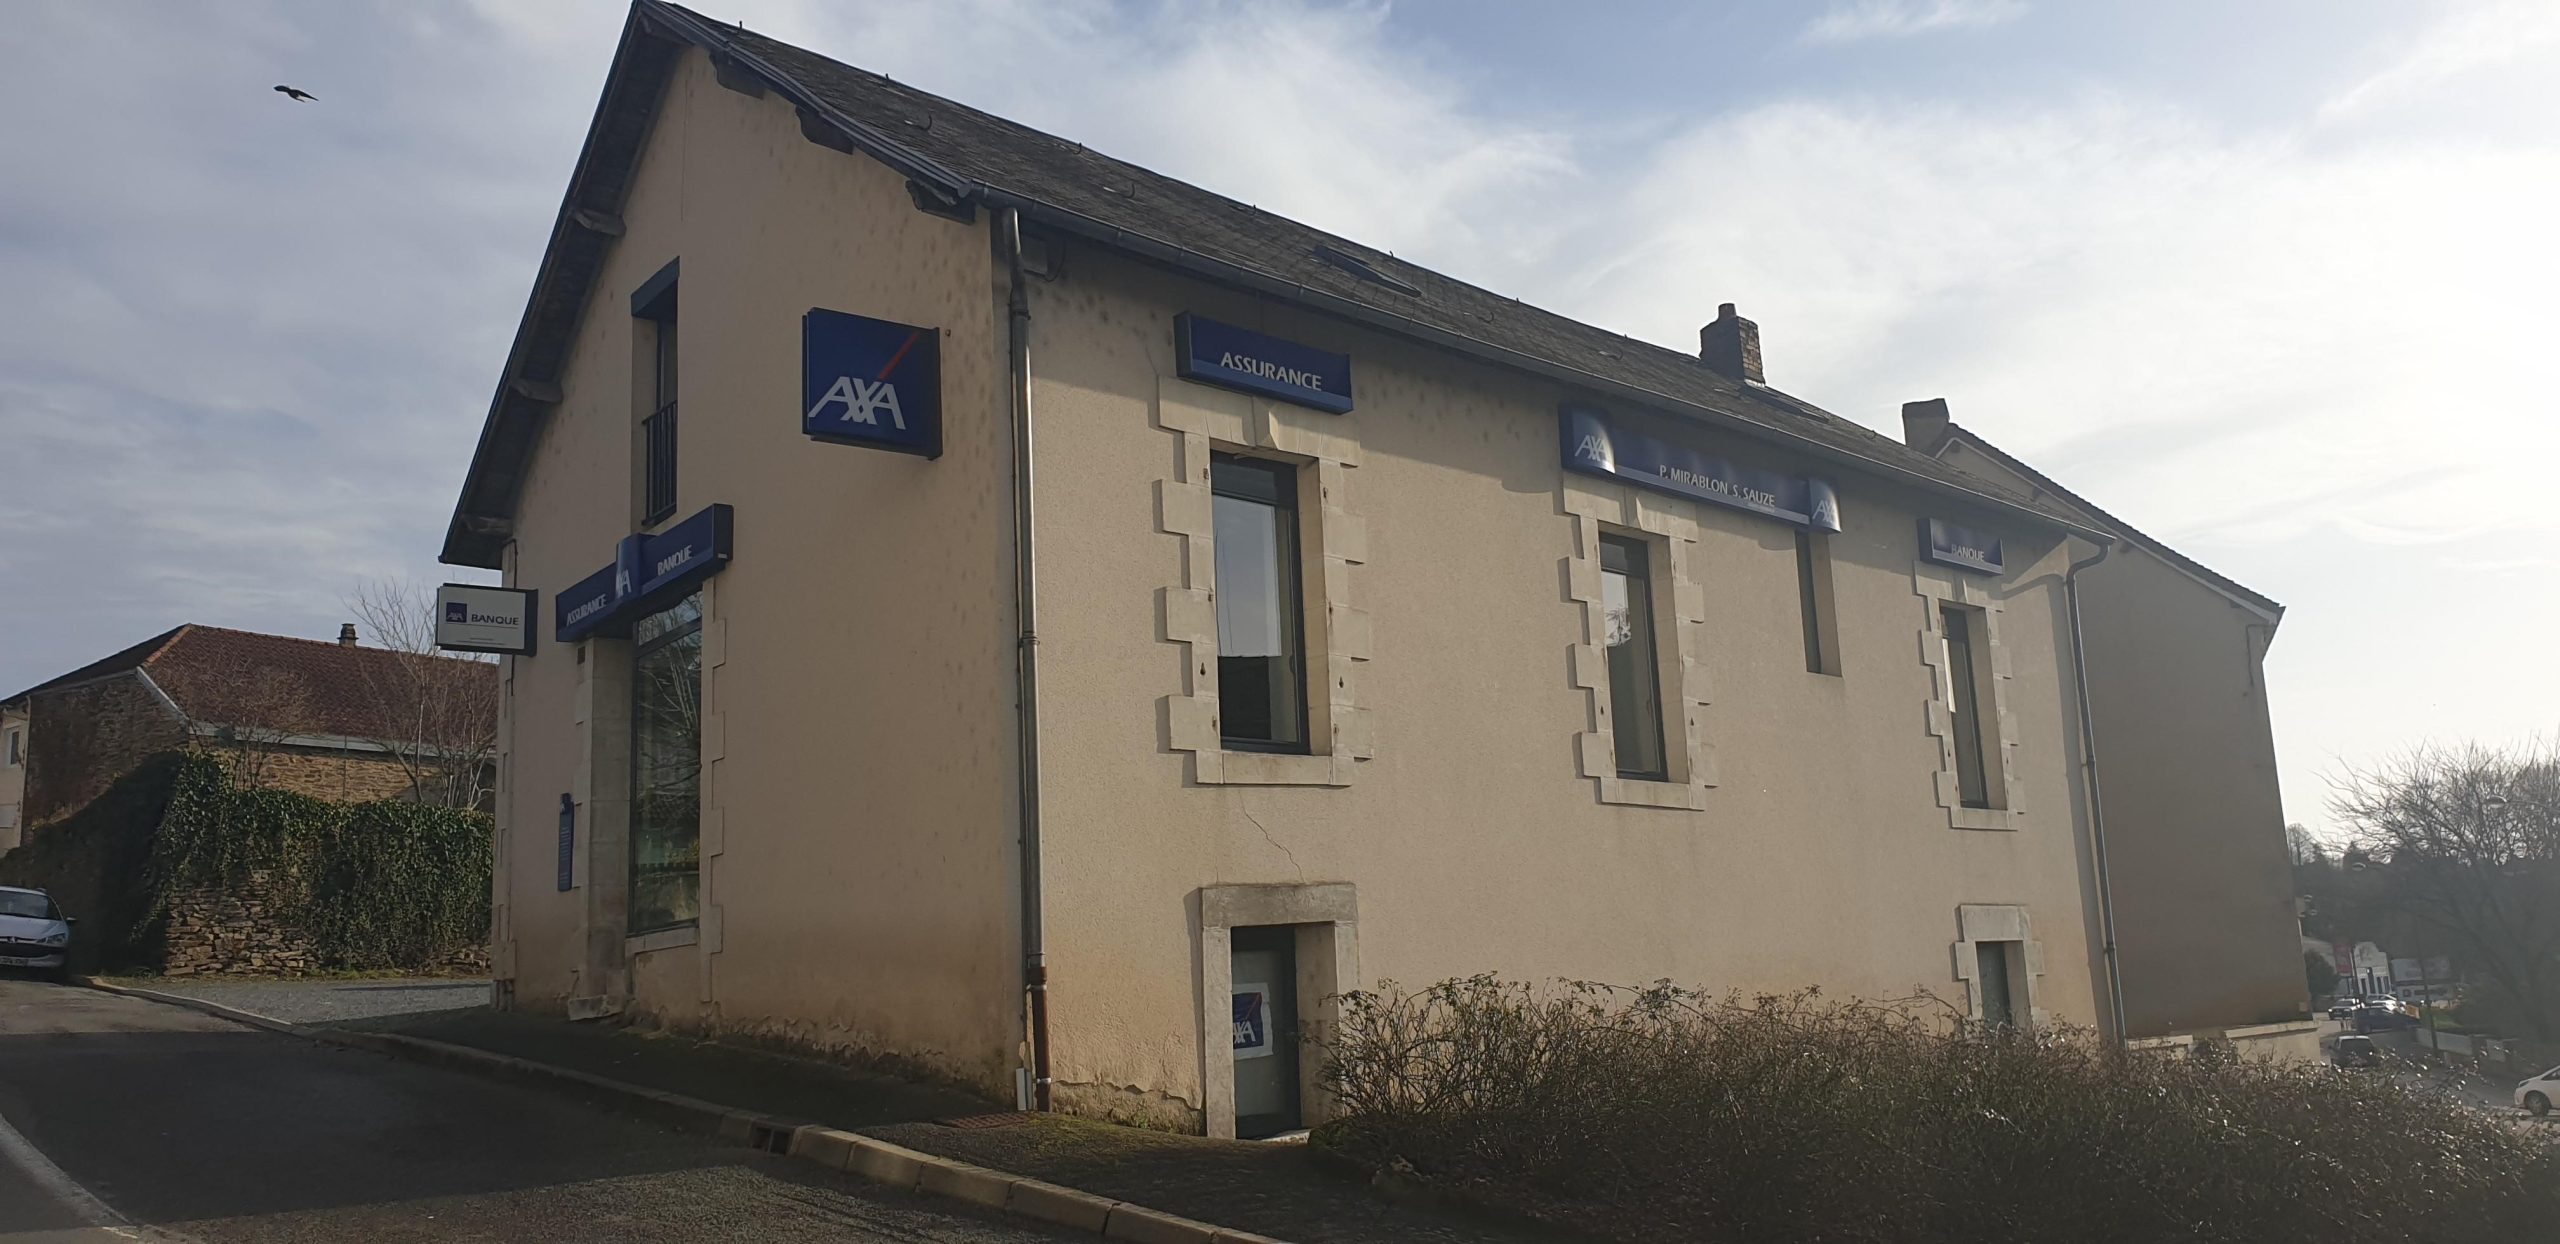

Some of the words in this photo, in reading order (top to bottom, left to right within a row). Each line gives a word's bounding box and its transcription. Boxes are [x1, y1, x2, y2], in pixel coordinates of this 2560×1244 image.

[1220, 351, 1322, 392] ASSURANCE
[807, 376, 906, 430] AXA
[1574, 434, 1609, 464] AXA
[1659, 464, 1669, 480] P.
[1670, 469, 1728, 495] MIRABLON
[1732, 484, 1742, 499] S.
[1743, 487, 1775, 508] SAUZE
[1951, 544, 1985, 561] BANQUE
[566, 593, 607, 627] ASSURANCE
[657, 544, 693, 576] BANQUE
[471, 613, 520, 626] BANQUE
